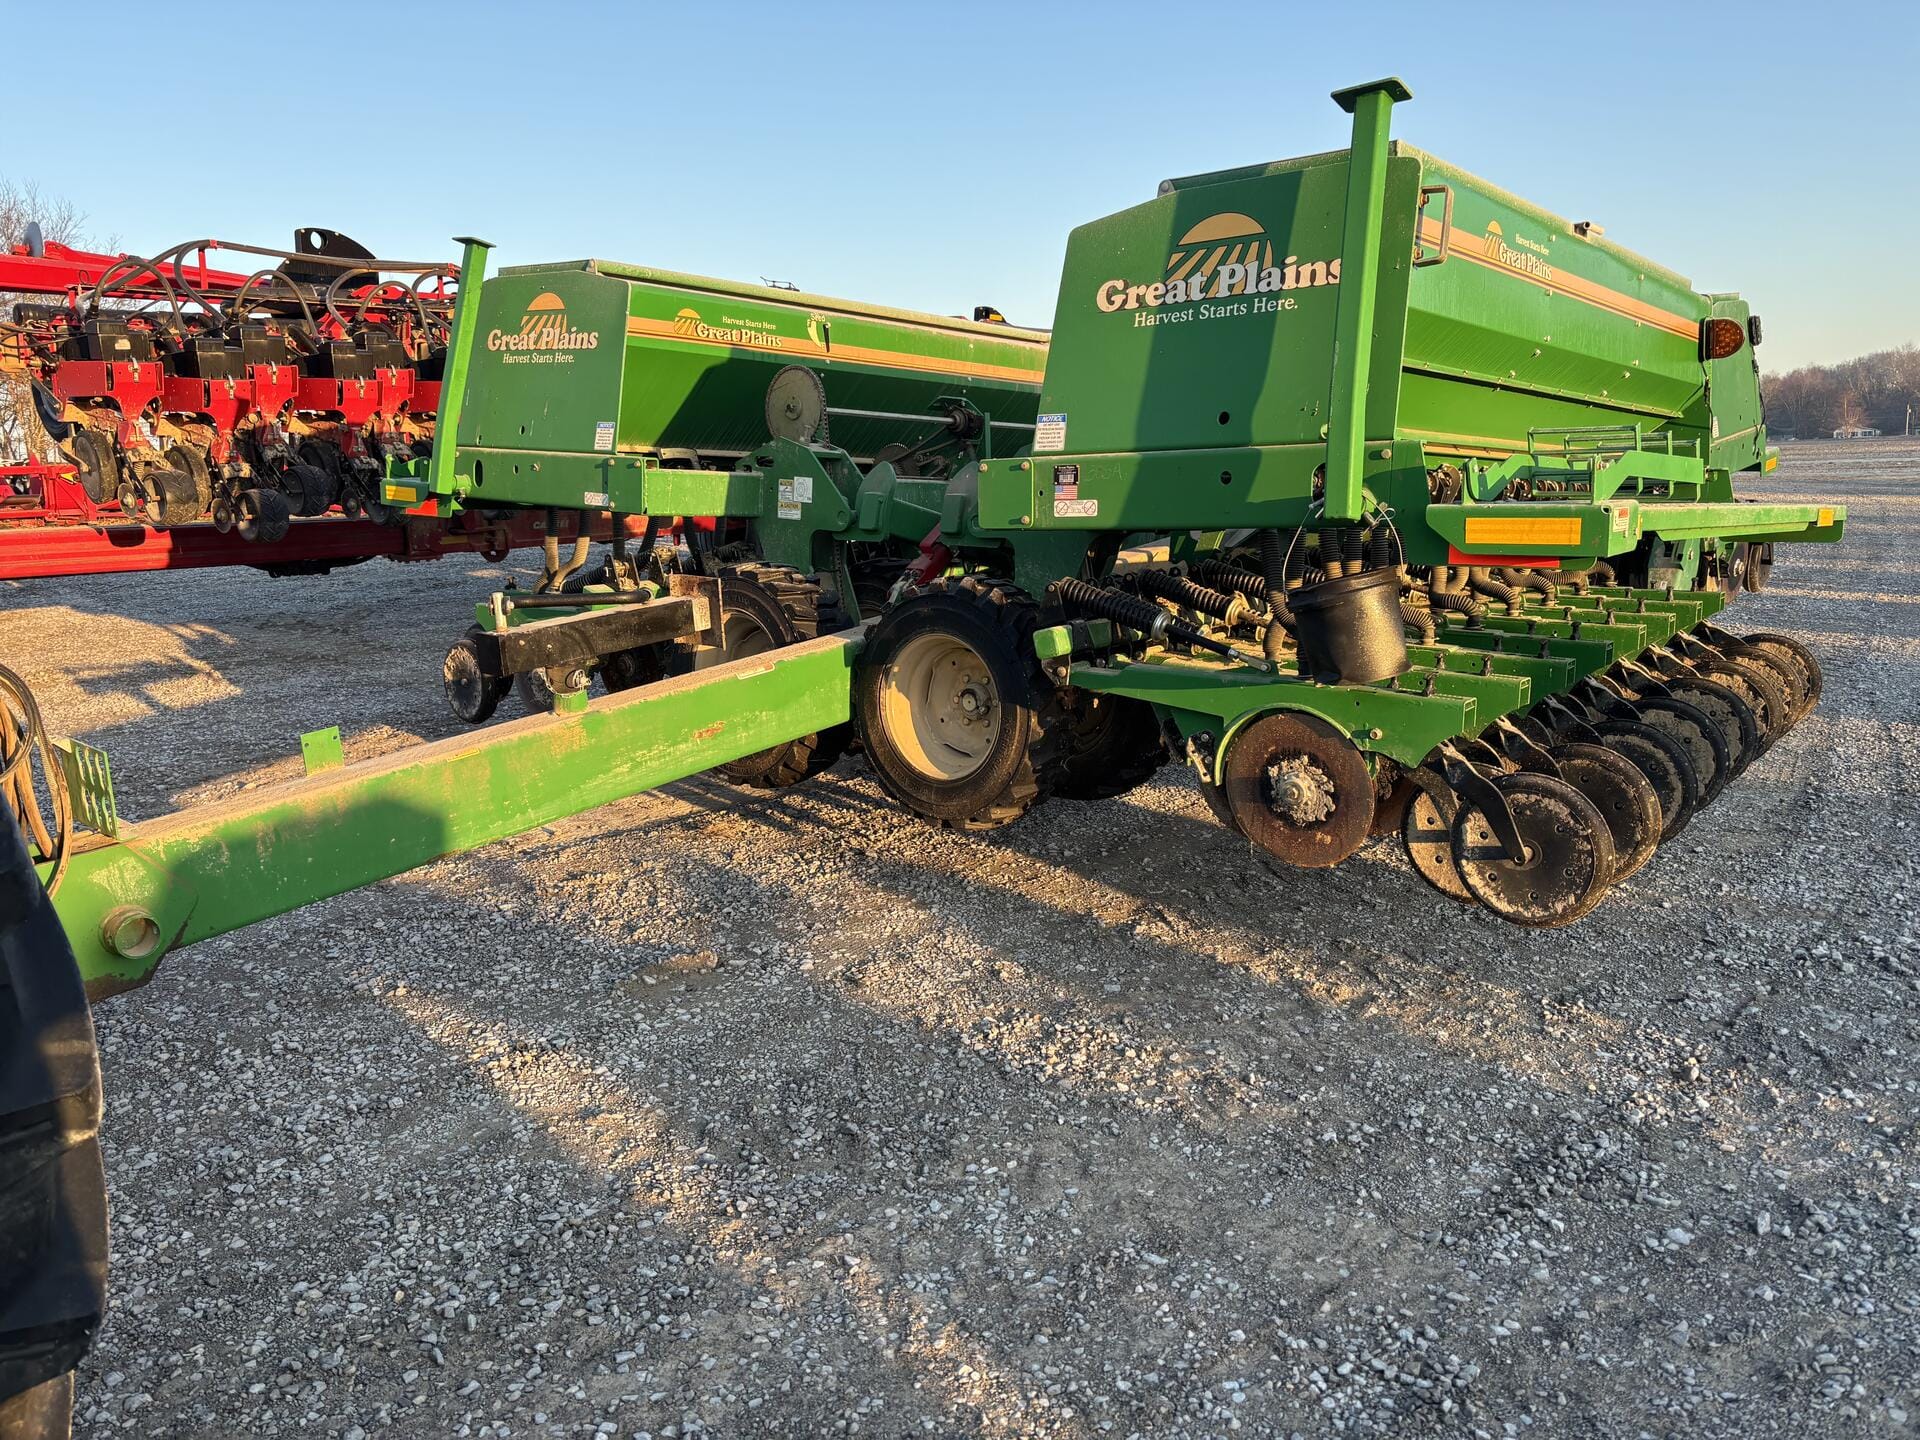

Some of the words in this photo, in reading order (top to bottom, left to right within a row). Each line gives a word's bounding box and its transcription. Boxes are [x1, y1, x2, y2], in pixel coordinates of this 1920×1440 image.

[1499, 242, 1526, 271] Great
[1526, 253, 1553, 281] Plains
[1096, 271, 1208, 314] Great
[722, 315, 745, 327] Harvest
[745, 319, 762, 329] Starts
[1133, 309, 1195, 328] Harvest
[1199, 303, 1248, 320] Starts
[1252, 297, 1299, 314] Here.
[487, 328, 538, 351] Great
[539, 326, 599, 350] Plains
[695, 323, 741, 342] Great
[741, 328, 783, 348] Plains
[502, 353, 530, 364] Harvest
[531, 352, 554, 363] Starts
[554, 352, 575, 363] Here.
[1041, 415, 1063, 423] NOTICE
